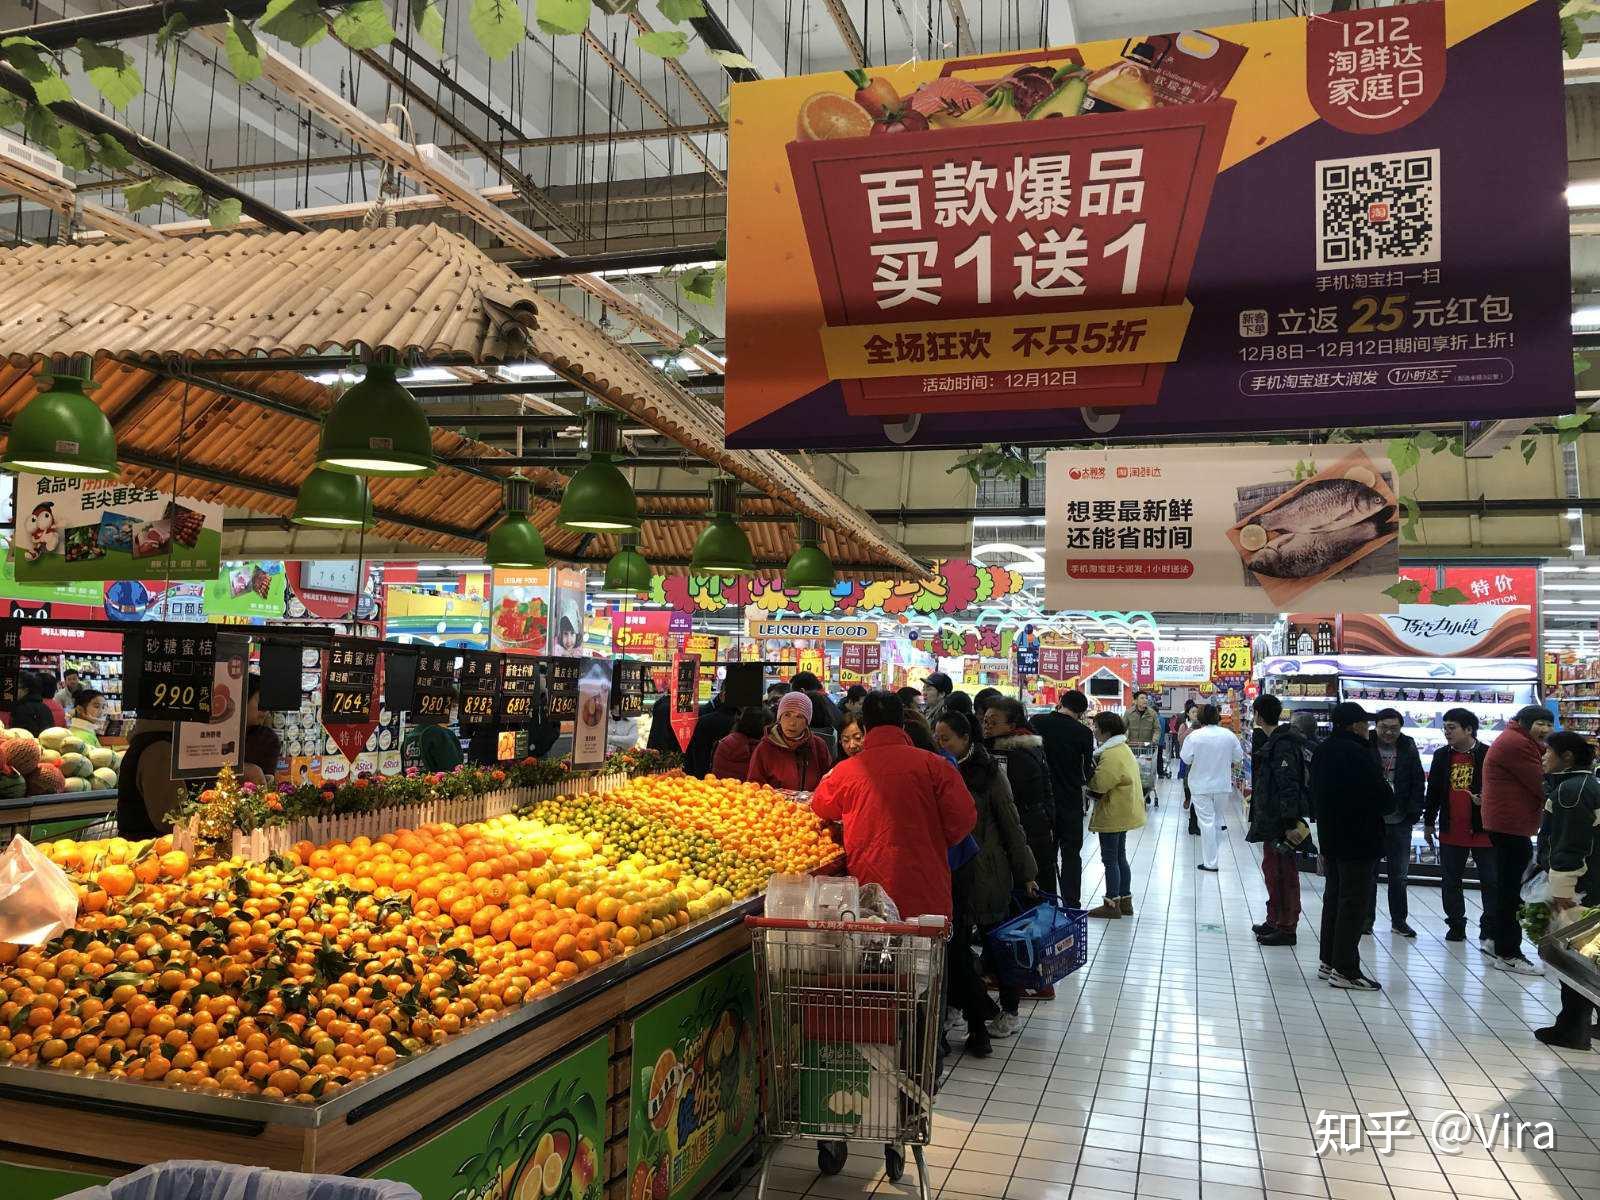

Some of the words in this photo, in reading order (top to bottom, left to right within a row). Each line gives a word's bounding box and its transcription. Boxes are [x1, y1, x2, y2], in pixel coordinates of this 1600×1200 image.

[1343, 17, 1410, 47] 1212
[1328, 43, 1423, 76] 淘鲜达
[1328, 69, 1424, 105] 家庭日
[860, 148, 1145, 233] 百款爆品
[870, 223, 1147, 310] 买1送1
[1315, 268, 1441, 292] 手机淘宝扫一扫
[1242, 312, 1266, 324] 新客
[1242, 324, 1266, 336] 下单
[864, 327, 992, 365] 全场狂欢
[1010, 318, 1148, 358] 不只5折
[1251, 370, 1379, 391] 手机淘宝逛大润发
[1395, 369, 1439, 382] 1小时达
[1067, 498, 1193, 523] 想要最新鲜
[1066, 526, 1193, 550] 还能省时间
[1471, 573, 1514, 598] 特价
[759, 625, 820, 636] LEISURE
[826, 626, 868, 636] FOOD
[146, 638, 213, 656] 砂糖蜜桔
[1220, 653, 1238, 668] 29
[340, 730, 363, 746] 特价
